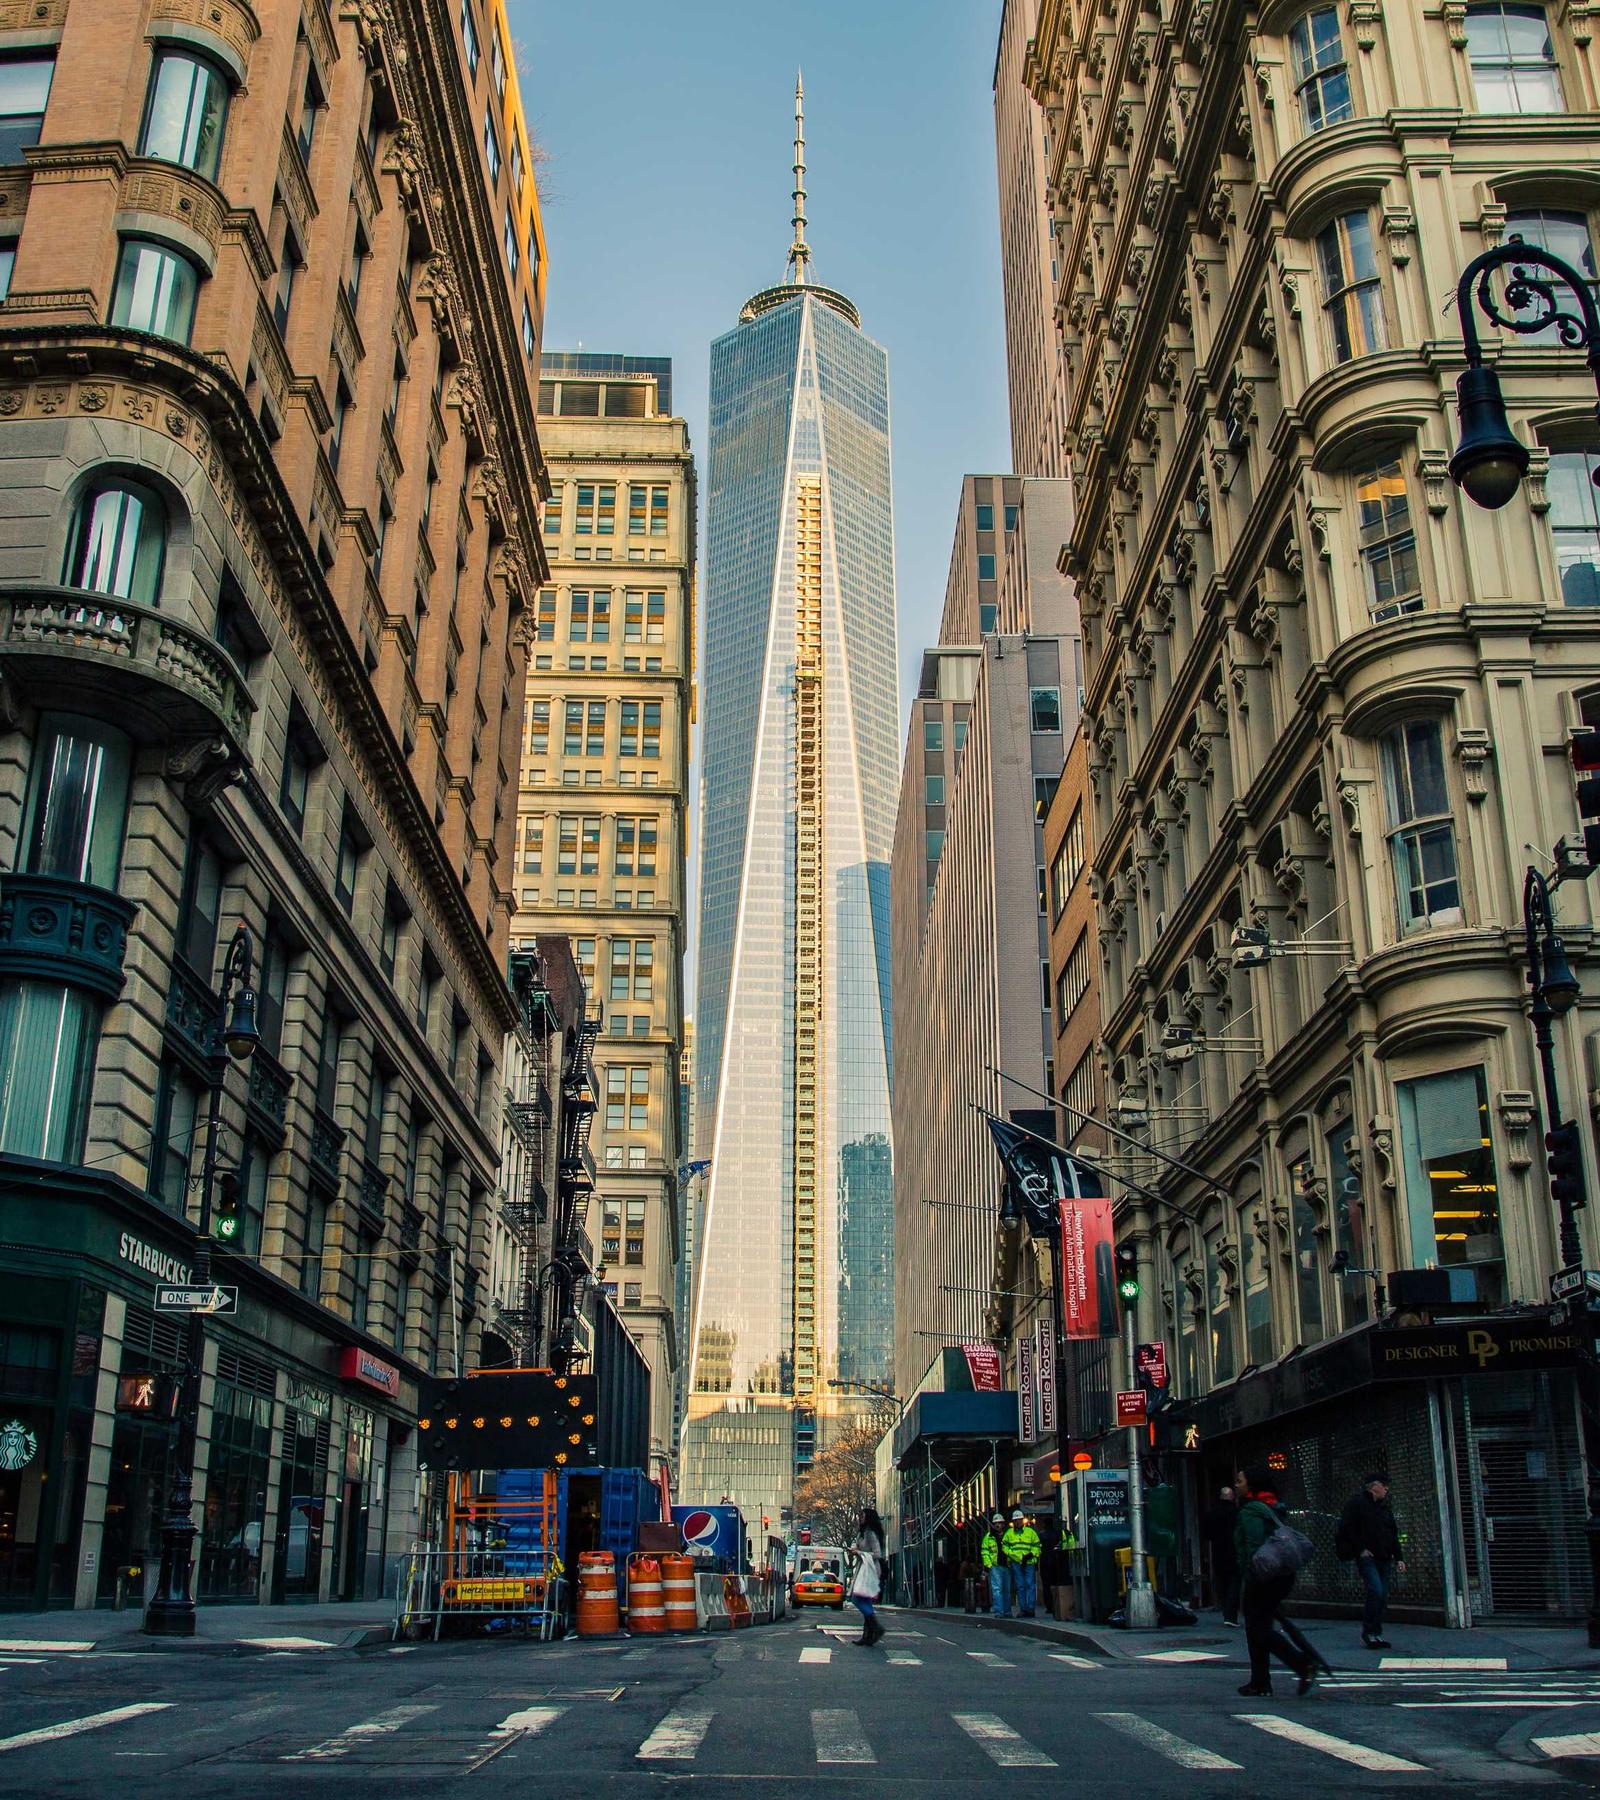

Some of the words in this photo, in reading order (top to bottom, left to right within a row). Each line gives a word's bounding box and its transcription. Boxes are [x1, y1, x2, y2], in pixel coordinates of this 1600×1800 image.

[1064, 1211, 1073, 1235] Lower
[120, 1232, 187, 1285] STARBUCKS
[1066, 1237, 1077, 1282] Manhattan
[167, 1292, 190, 1304] ONE
[1067, 1283, 1080, 1319] Hospital
[1021, 1339, 1032, 1394] Roberts
[1040, 1320, 1051, 1379] Roberts
[1385, 1345, 1459, 1361] DESIGNER
[1023, 1396, 1032, 1441] Lucille
[1043, 1381, 1052, 1430] Lucille
[1090, 1490, 1125, 1498] DEVIOUS
[1095, 1498, 1120, 1506] MAIDS
[461, 1586, 482, 1594] Hertz
